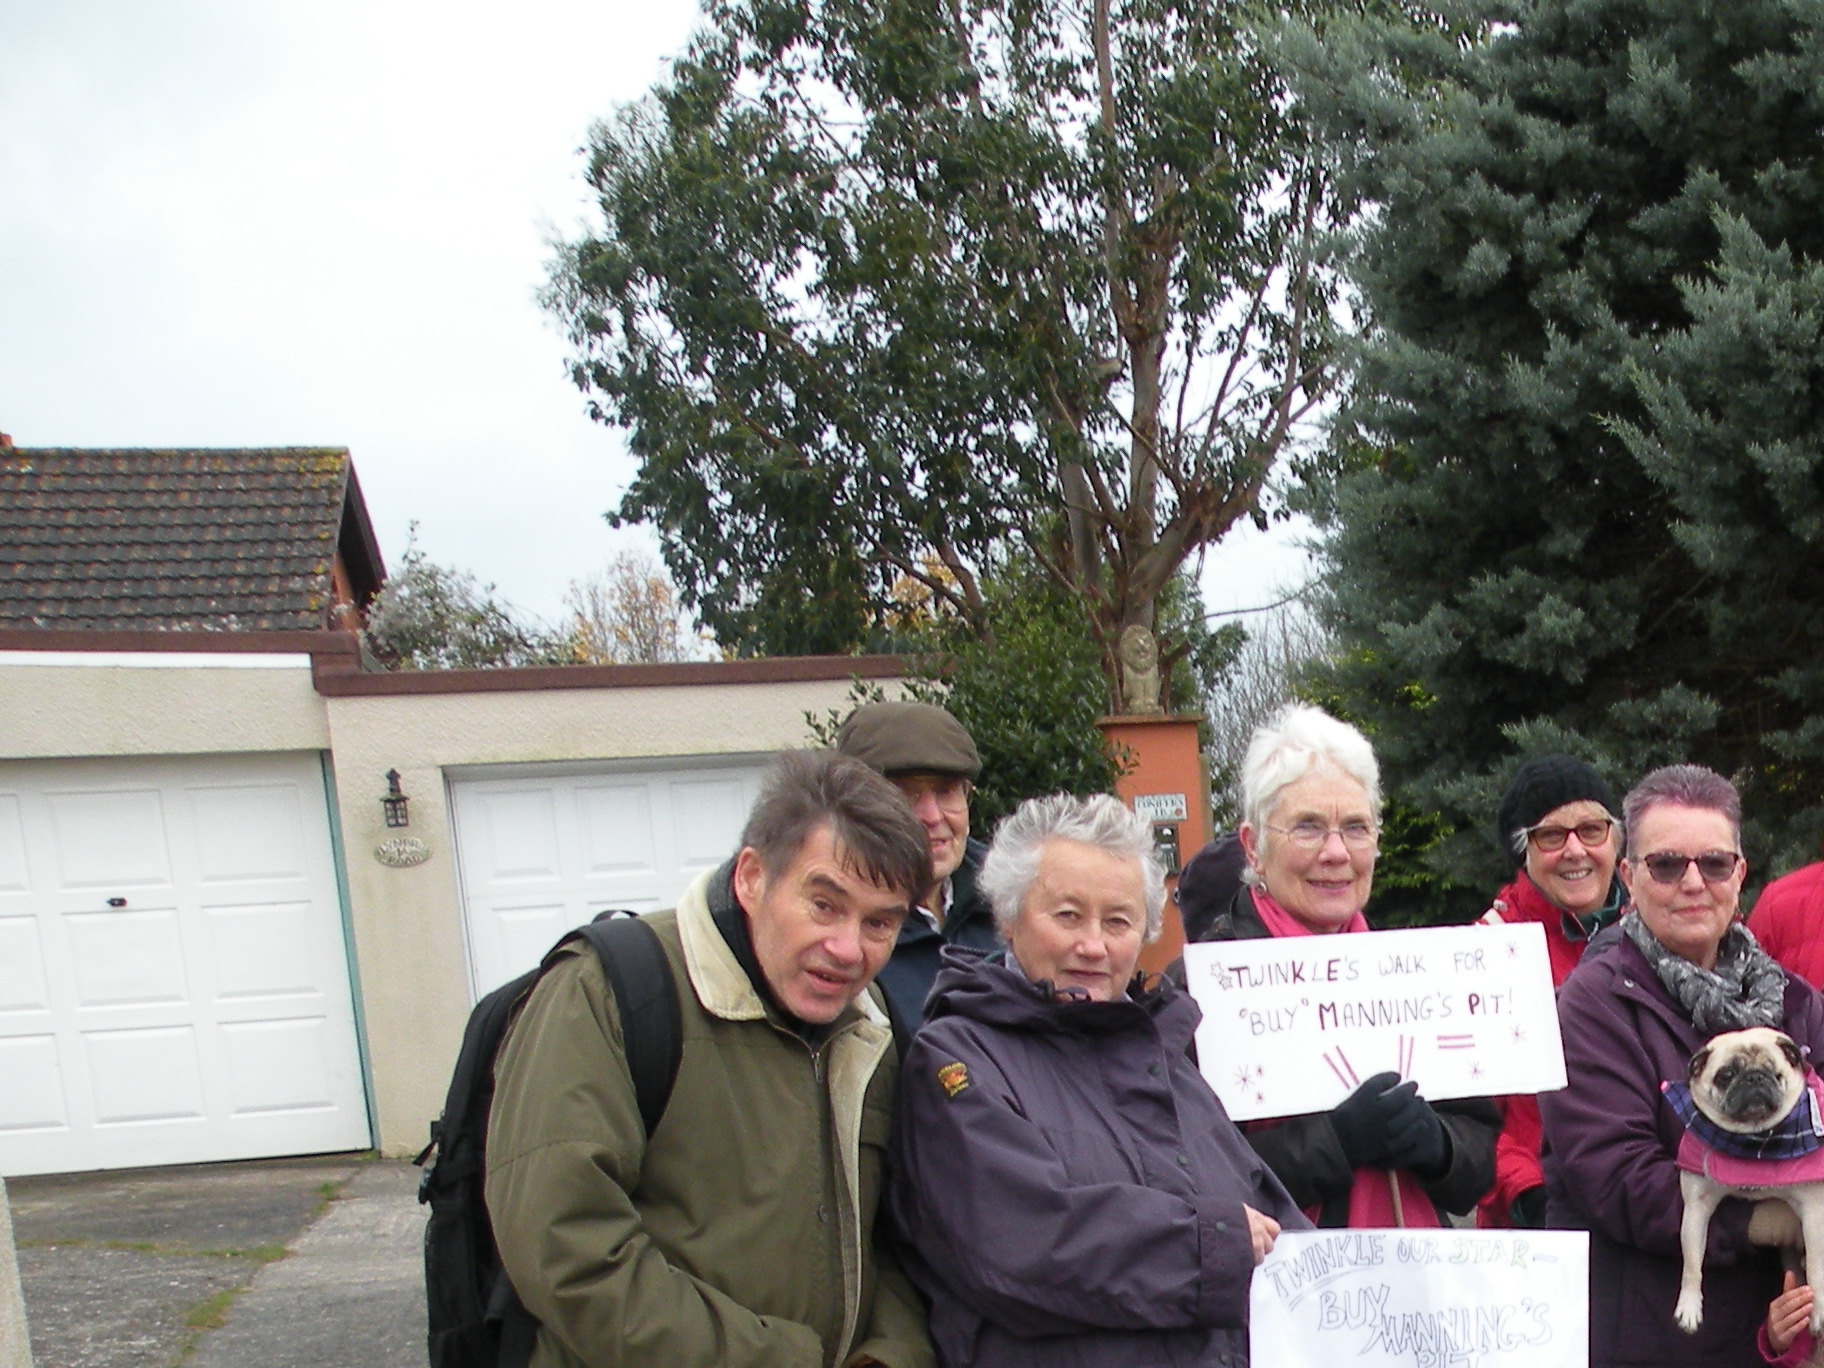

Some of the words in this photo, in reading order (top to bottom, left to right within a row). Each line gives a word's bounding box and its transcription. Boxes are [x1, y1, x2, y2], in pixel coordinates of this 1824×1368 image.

[1228, 956, 1360, 989] TWINKLE'S
[1378, 953, 1426, 977] WALK
[1453, 948, 1486, 973] FOR
[1319, 991, 1453, 1031] MANNING'S
[1468, 987, 1513, 1015] PIT!
[1264, 1233, 1386, 1298] TWINKLE
[1397, 1236, 1442, 1265] OUR
[1317, 1283, 1390, 1331] BUY
[1357, 1296, 1553, 1356] MANNING'S
